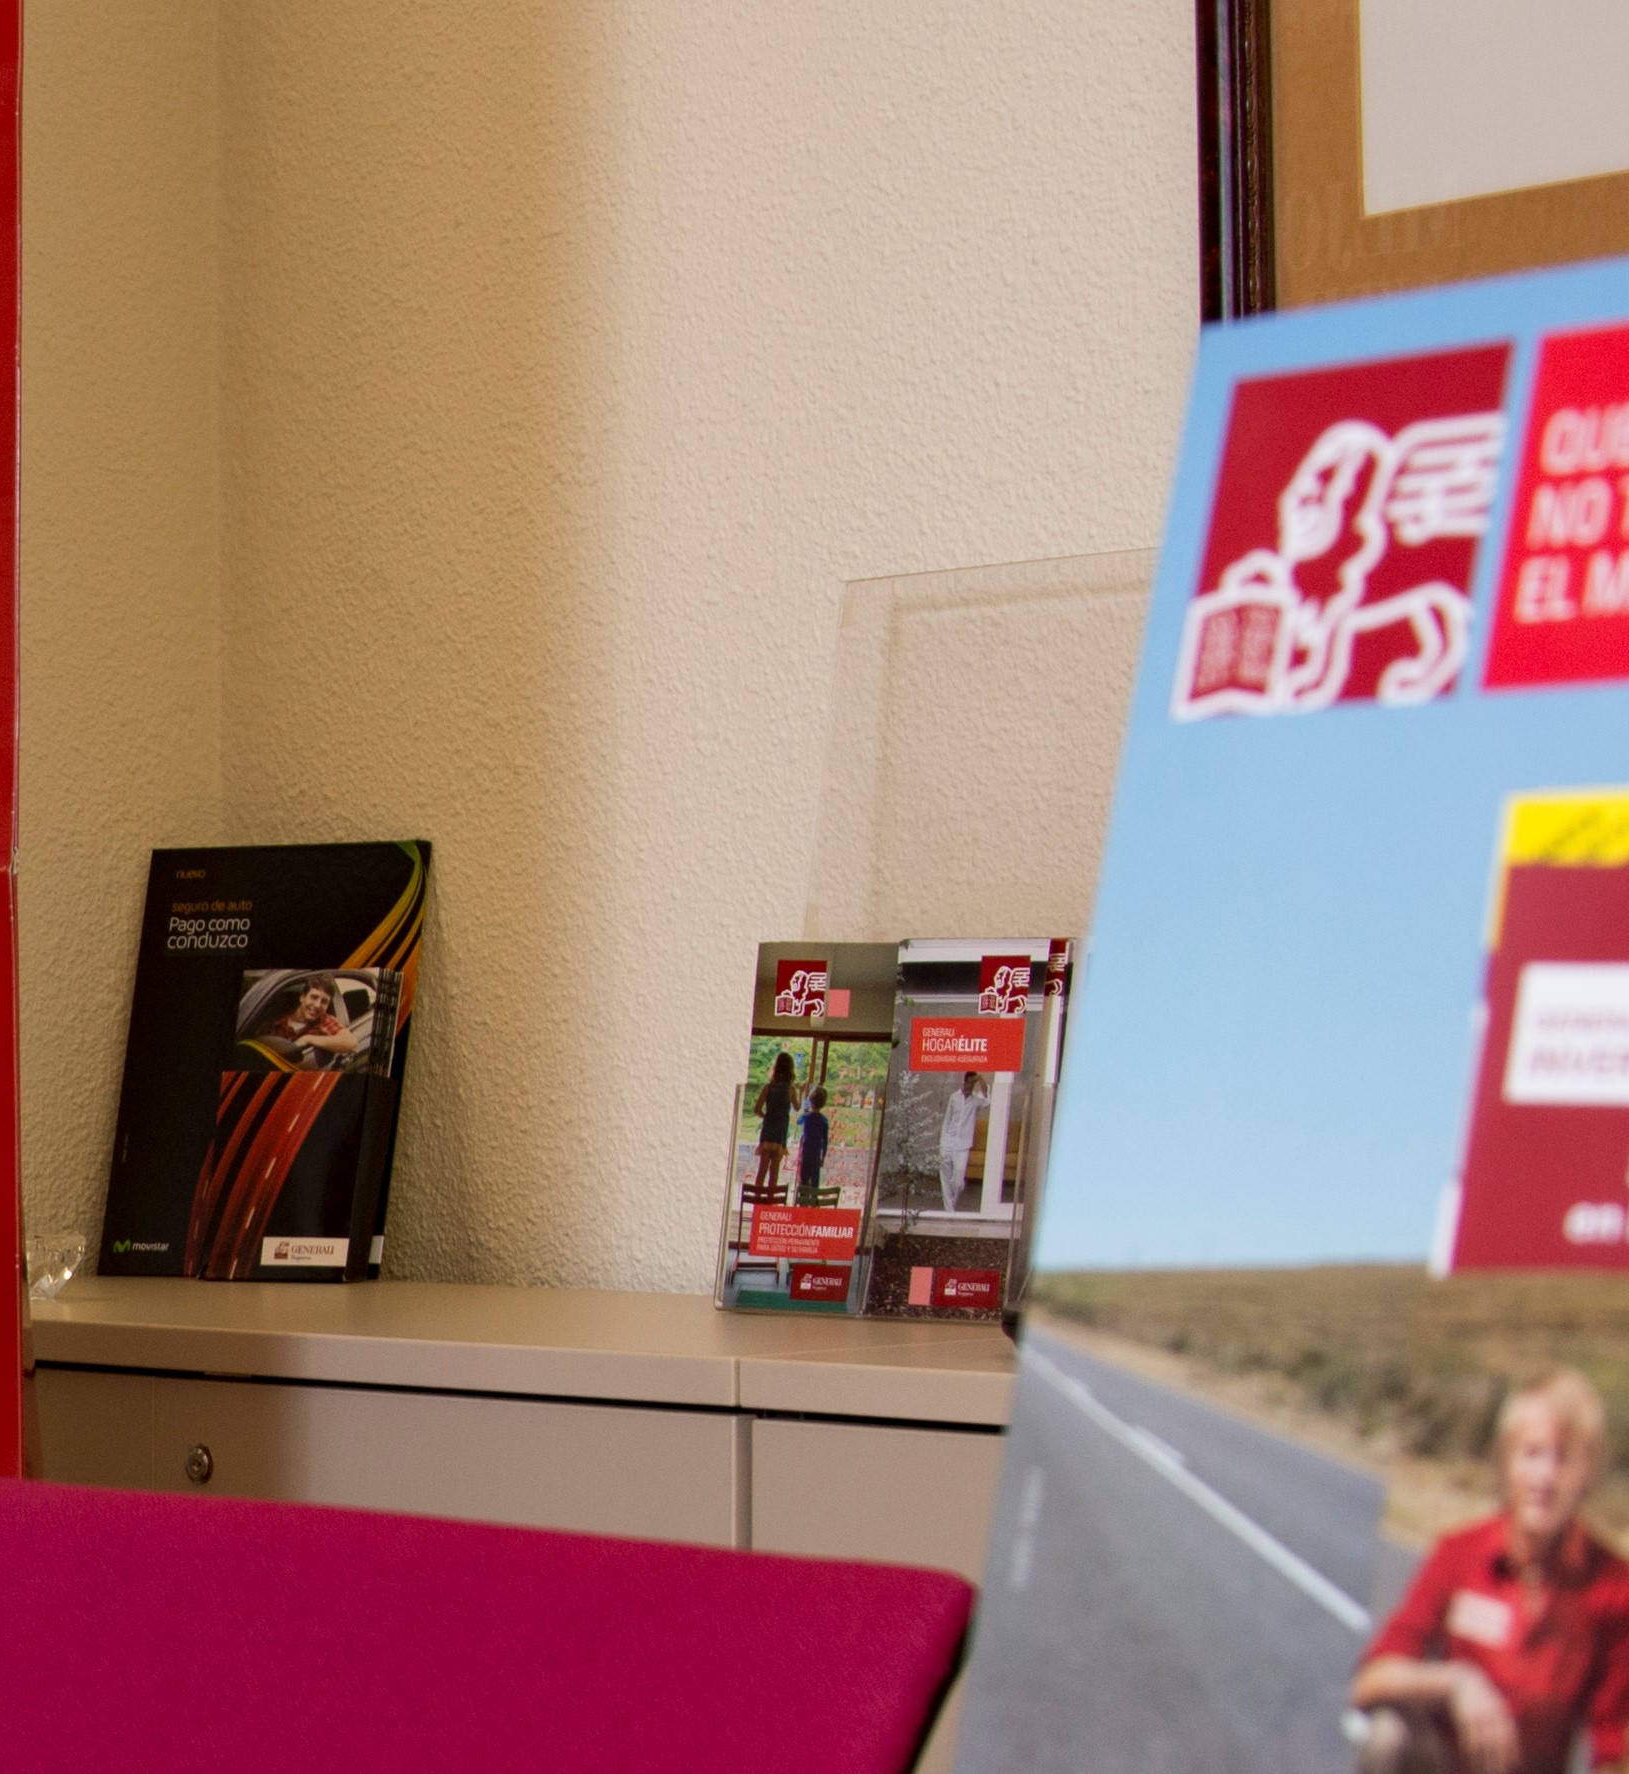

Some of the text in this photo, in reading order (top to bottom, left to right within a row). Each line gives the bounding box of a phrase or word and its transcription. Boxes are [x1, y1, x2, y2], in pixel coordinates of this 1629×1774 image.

[172, 899, 253, 915] seguro de auto
[168, 916, 251, 935] Pago como
[167, 931, 249, 950] conduzco
[132, 1241, 170, 1251] movistar
[291, 1245, 334, 1255] GENERALI
